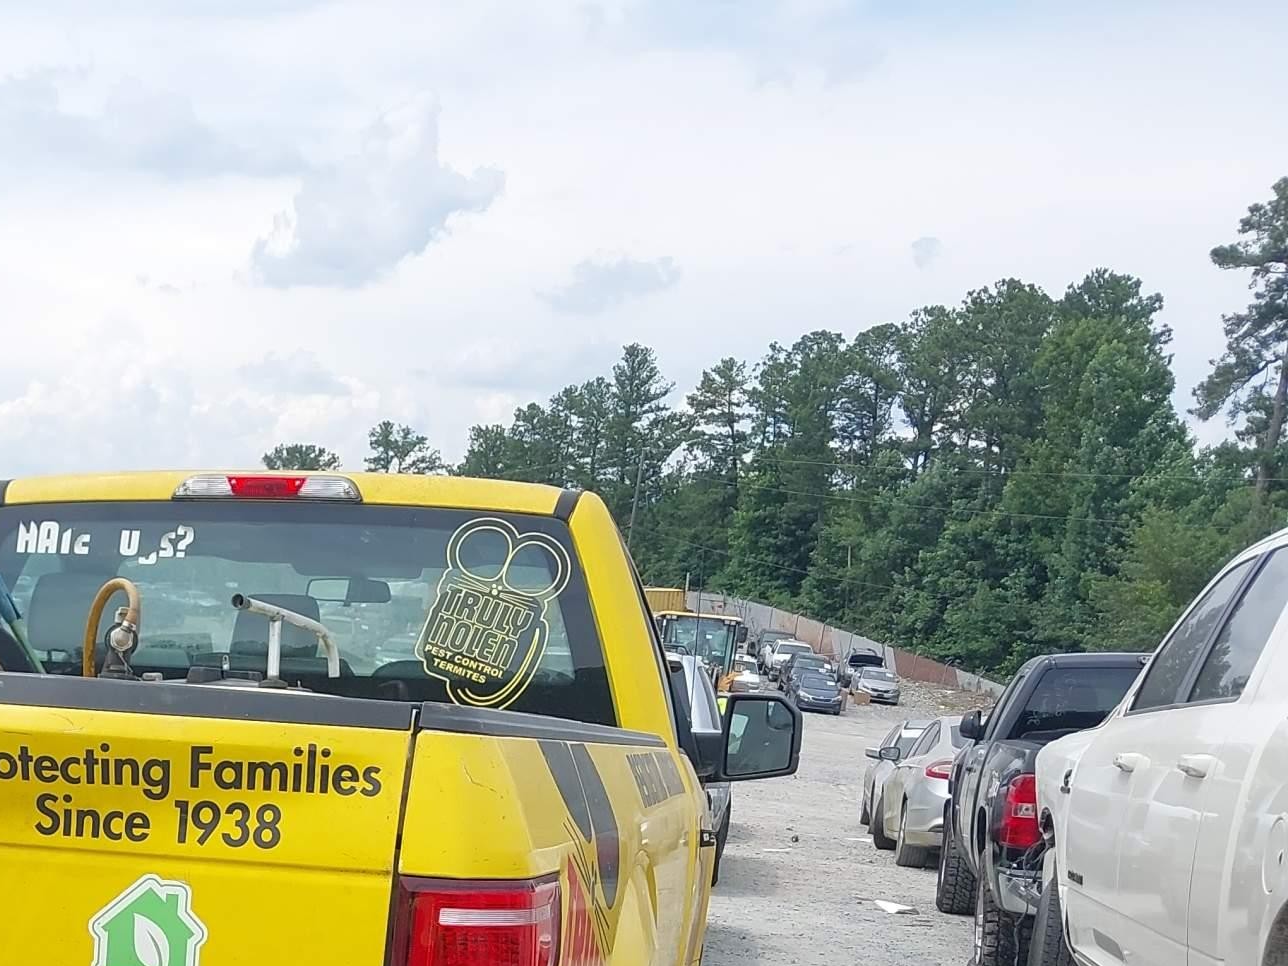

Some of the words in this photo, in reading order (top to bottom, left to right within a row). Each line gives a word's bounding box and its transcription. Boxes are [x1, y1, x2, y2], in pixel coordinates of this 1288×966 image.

[441, 584, 535, 639] TRULY
[423, 644, 452, 661] PEST
[454, 654, 504, 679] CONTROL
[428, 613, 519, 671] NOLEN
[432, 657, 487, 684] TERMITES
[189, 743, 383, 797] Families
[35, 793, 151, 842] Since
[174, 800, 282, 849] 1938
